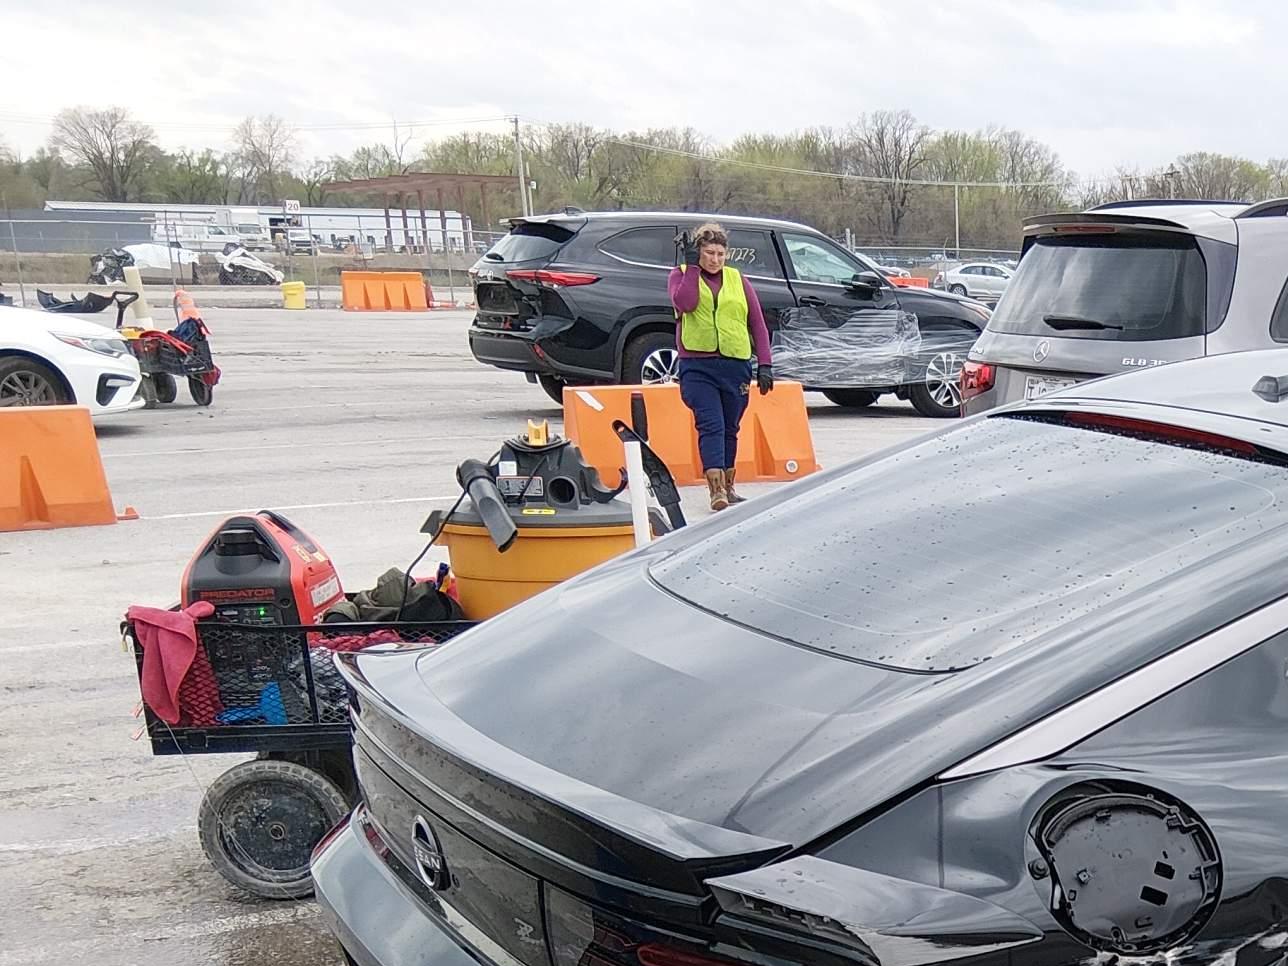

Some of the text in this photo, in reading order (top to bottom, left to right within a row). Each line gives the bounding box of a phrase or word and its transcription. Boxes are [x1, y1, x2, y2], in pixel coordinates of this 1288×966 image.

[288, 203, 299, 211] 20
[1122, 358, 1147, 366] GLB
[200, 589, 275, 598] PREDATOR
